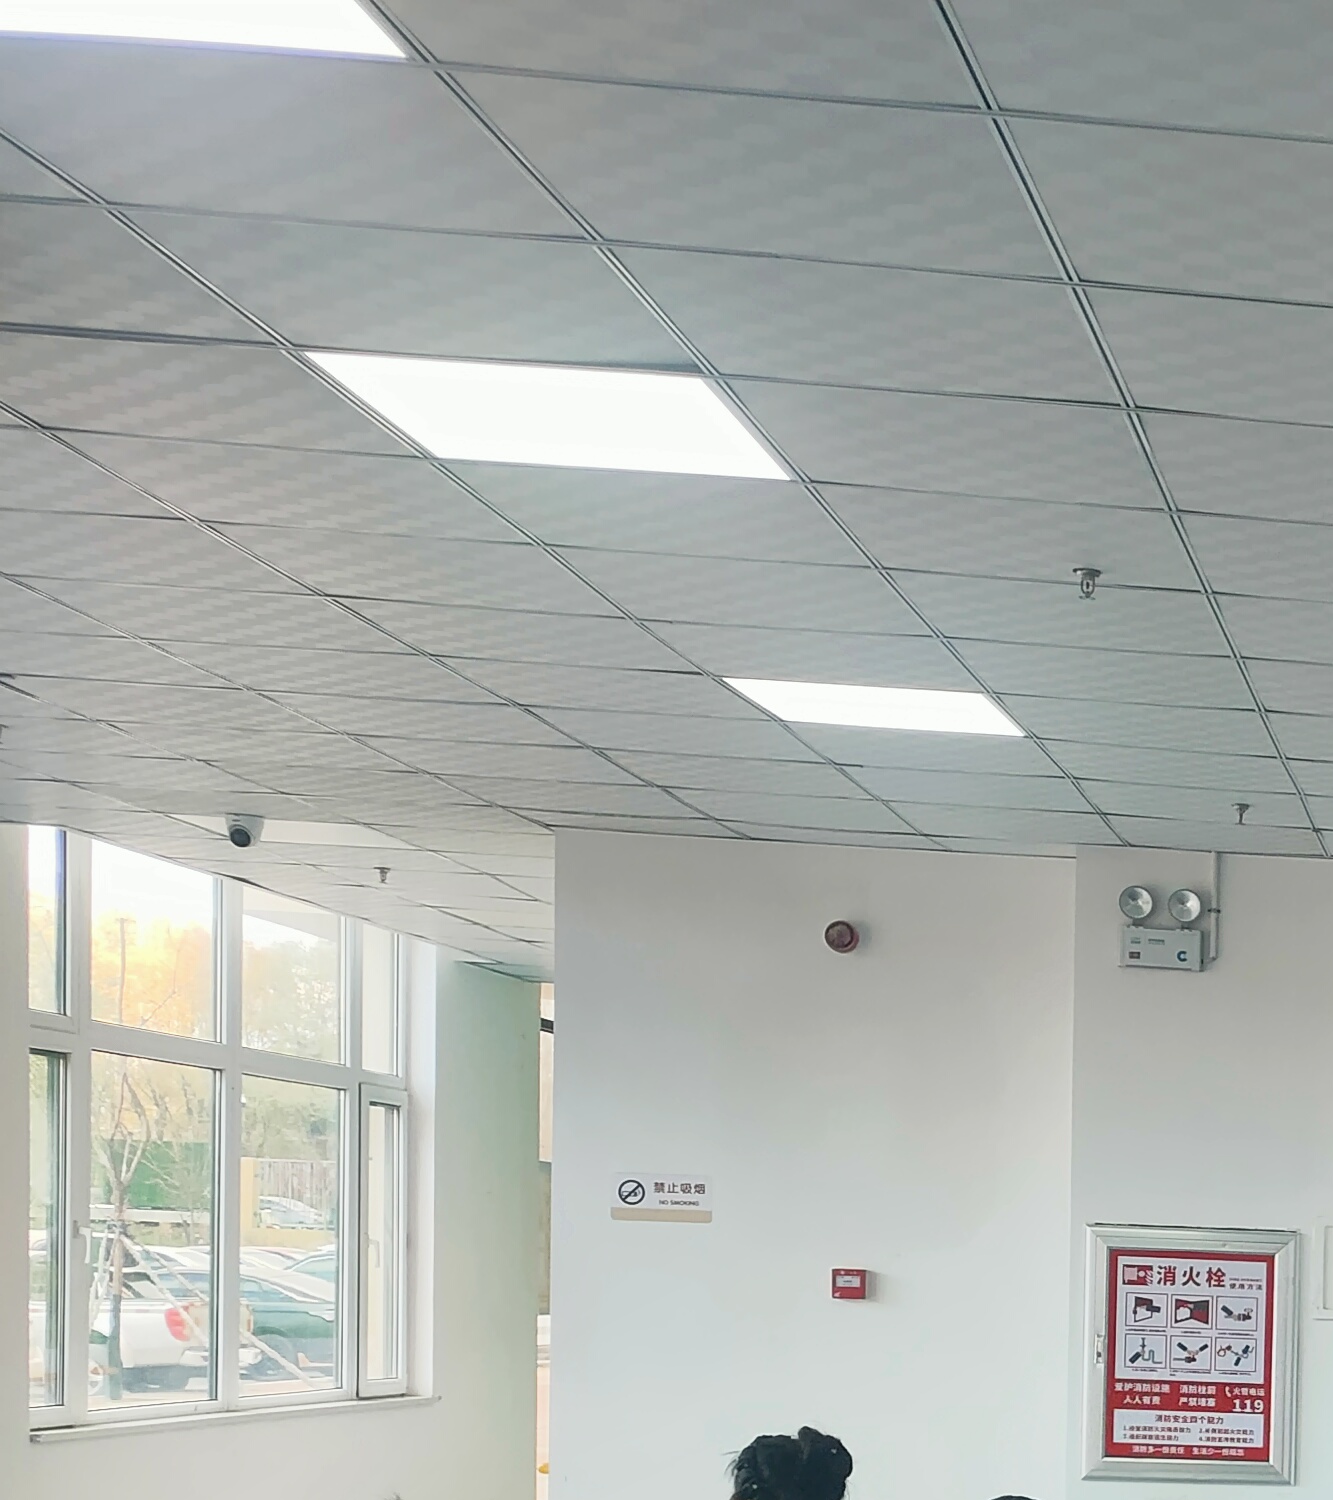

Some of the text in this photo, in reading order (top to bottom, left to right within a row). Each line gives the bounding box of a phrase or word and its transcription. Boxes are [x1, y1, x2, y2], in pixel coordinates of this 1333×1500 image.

[653, 1181, 706, 1194] 禁止吸烟
[1157, 1265, 1226, 1288] 消火栓
[1123, 1395, 1161, 1405] 人人有责
[1232, 1399, 1265, 1413] 119
[1154, 1414, 1224, 1425] 消防安全四个能力
